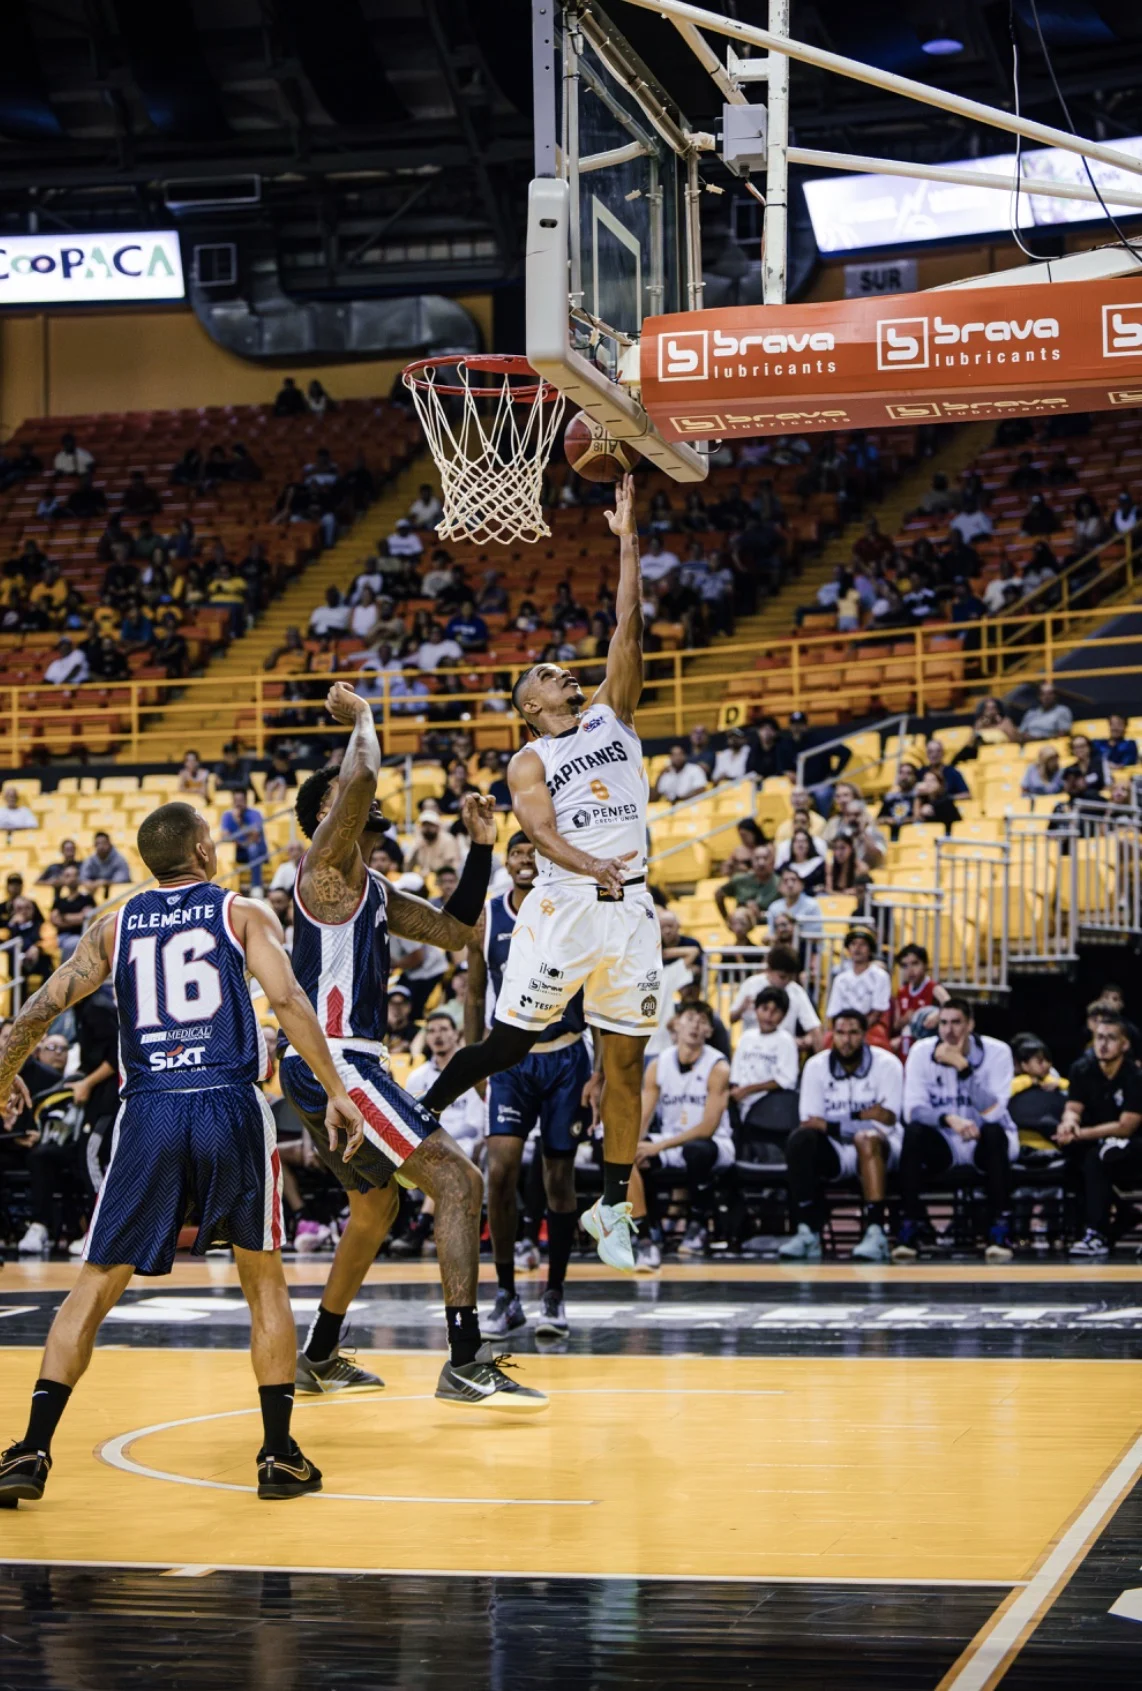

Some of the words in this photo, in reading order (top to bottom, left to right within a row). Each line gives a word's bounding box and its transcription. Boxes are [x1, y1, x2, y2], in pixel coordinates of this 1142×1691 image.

[860, 268, 902, 291] SUR
[934, 316, 1060, 344] brava
[713, 330, 835, 357] brava
[935, 347, 1060, 367] lubricants
[714, 360, 836, 379] lubricants
[942, 397, 1067, 411] brava
[947, 403, 1069, 416] lubricants
[725, 409, 848, 423] brava
[731, 417, 851, 431] lubricants
[592, 803, 637, 819] PENFED
[127, 904, 215, 930] CLEMENTE
[127, 927, 223, 1029] 16
[166, 1026, 212, 1040] MEDICAL
